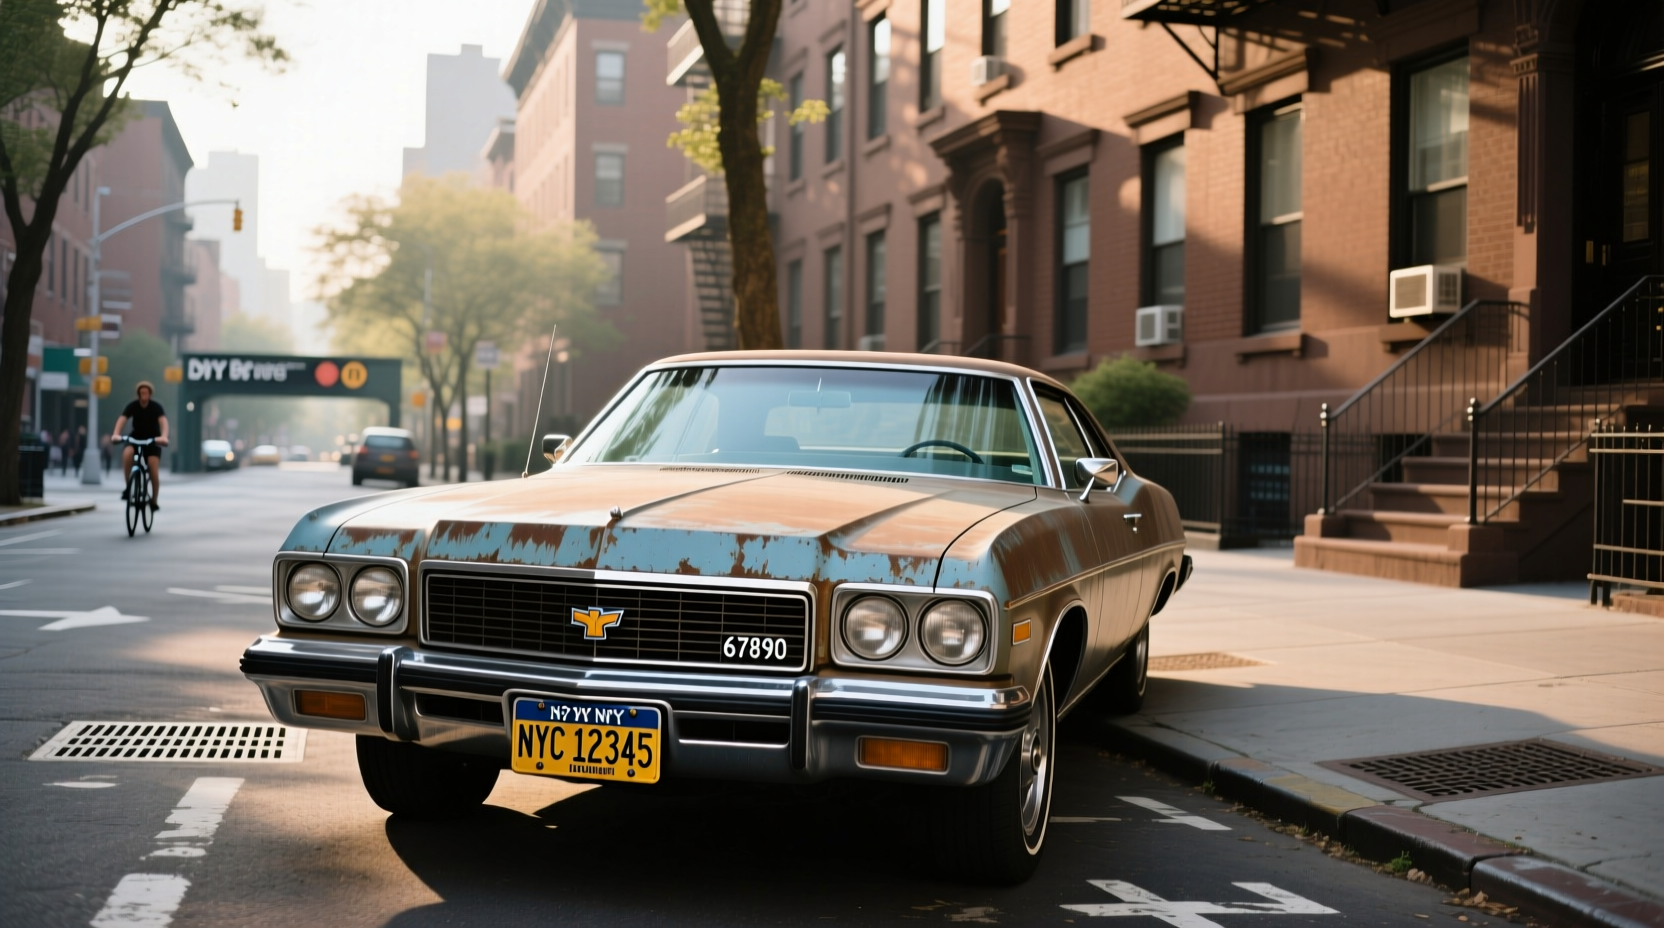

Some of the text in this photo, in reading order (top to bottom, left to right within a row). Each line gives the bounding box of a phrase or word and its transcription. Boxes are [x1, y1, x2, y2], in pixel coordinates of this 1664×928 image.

[723, 636, 787, 660] 67890
[518, 724, 653, 768] NYC 12345
